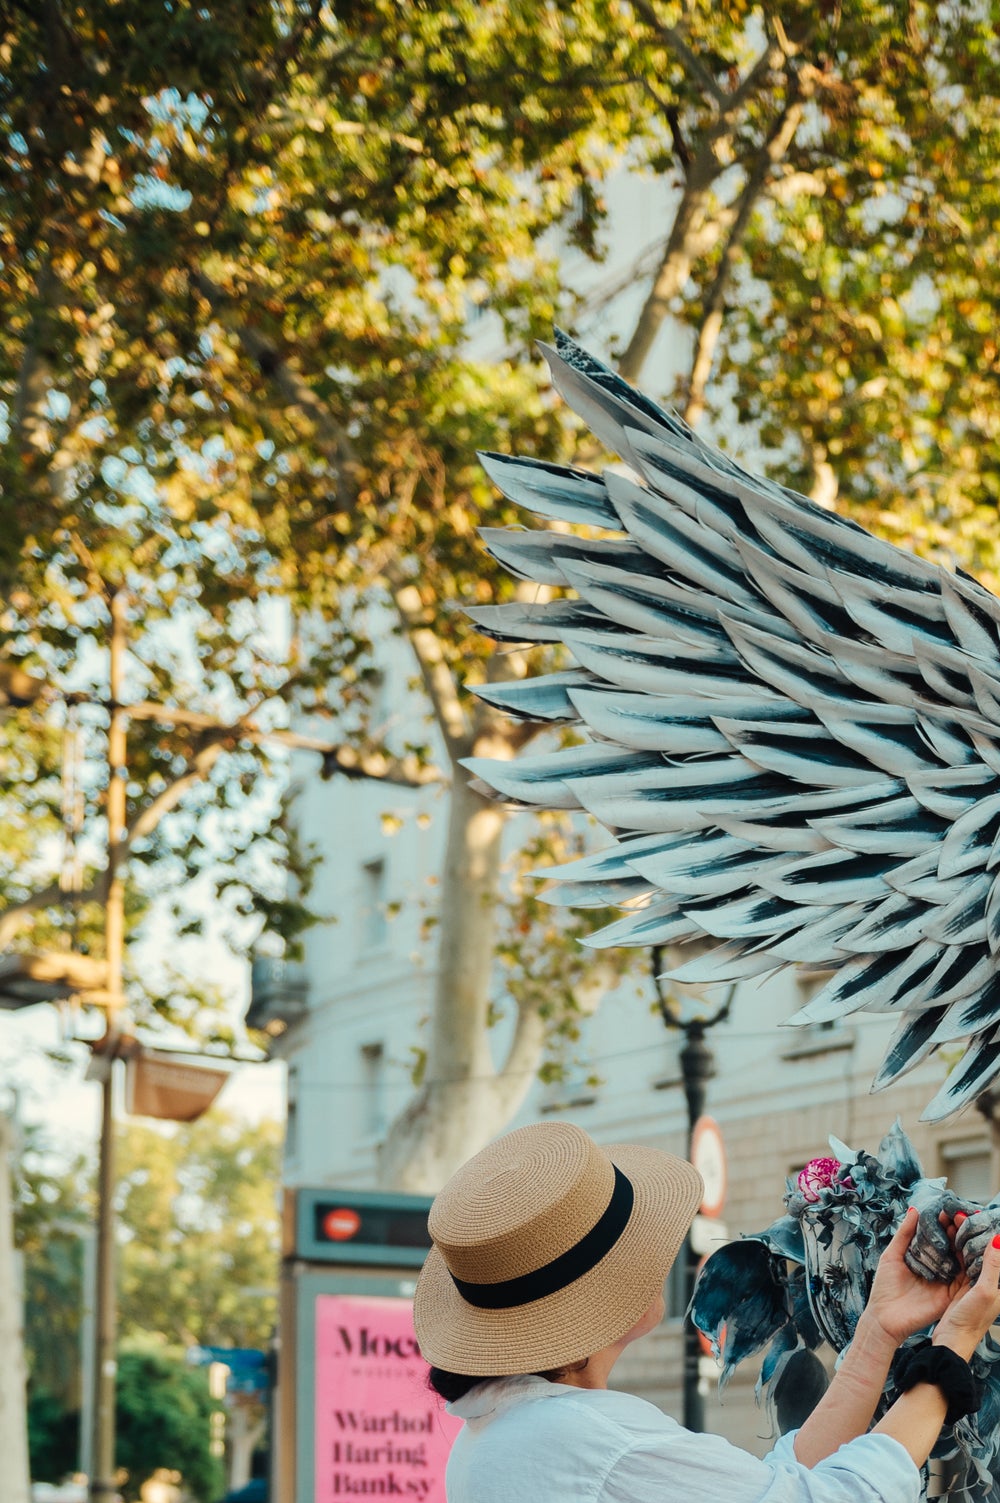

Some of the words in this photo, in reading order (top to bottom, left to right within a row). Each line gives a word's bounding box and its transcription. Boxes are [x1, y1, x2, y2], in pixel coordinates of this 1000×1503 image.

[334, 1409, 433, 1433] Warhol
[333, 1440, 427, 1467] Haring
[333, 1471, 434, 1502] Banksy
